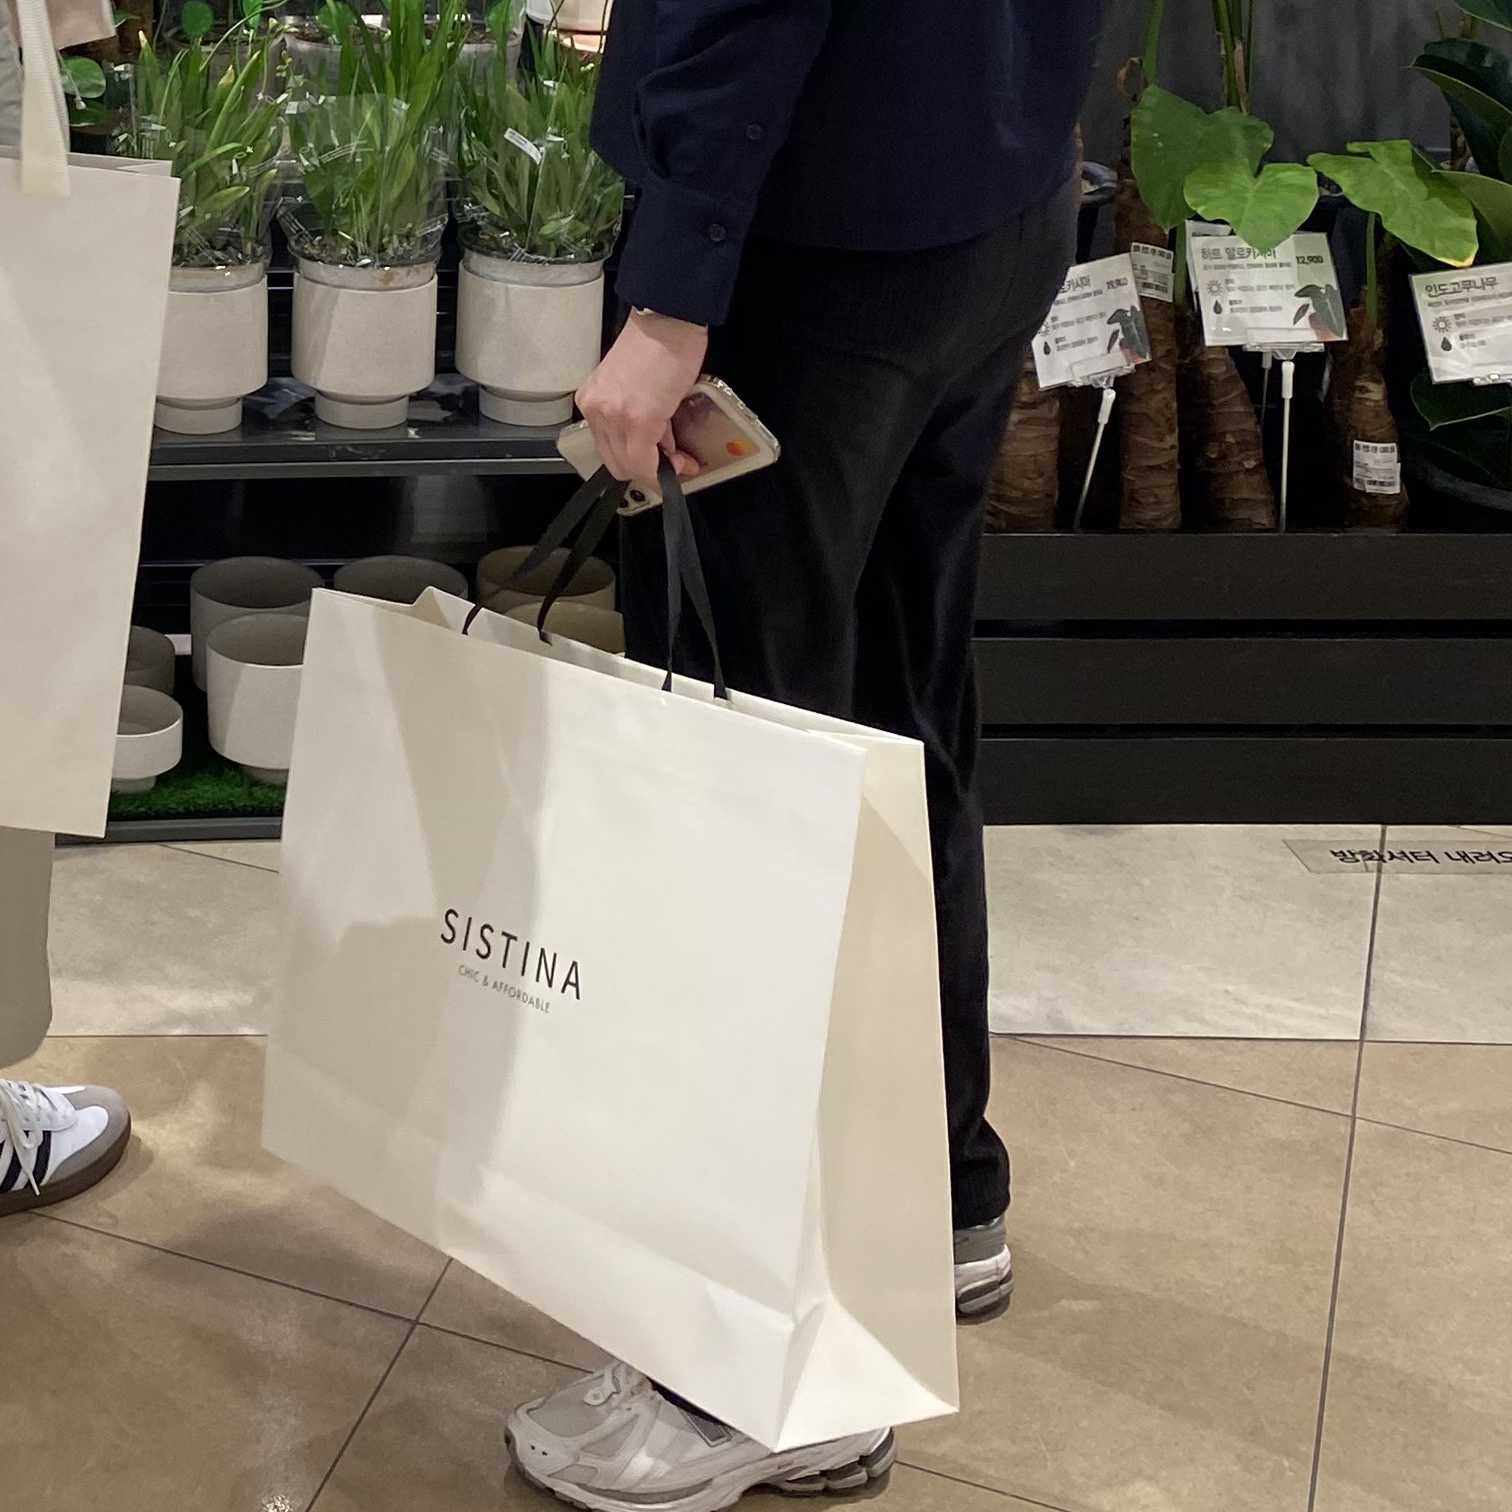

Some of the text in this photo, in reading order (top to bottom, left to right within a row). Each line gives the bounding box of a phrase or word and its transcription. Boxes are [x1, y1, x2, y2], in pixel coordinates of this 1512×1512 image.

[1424, 276, 1499, 298] 인도고무나무
[440, 908, 581, 1001] SISTINA
[457, 964, 551, 1014] CHIC & AFFORDABLE
